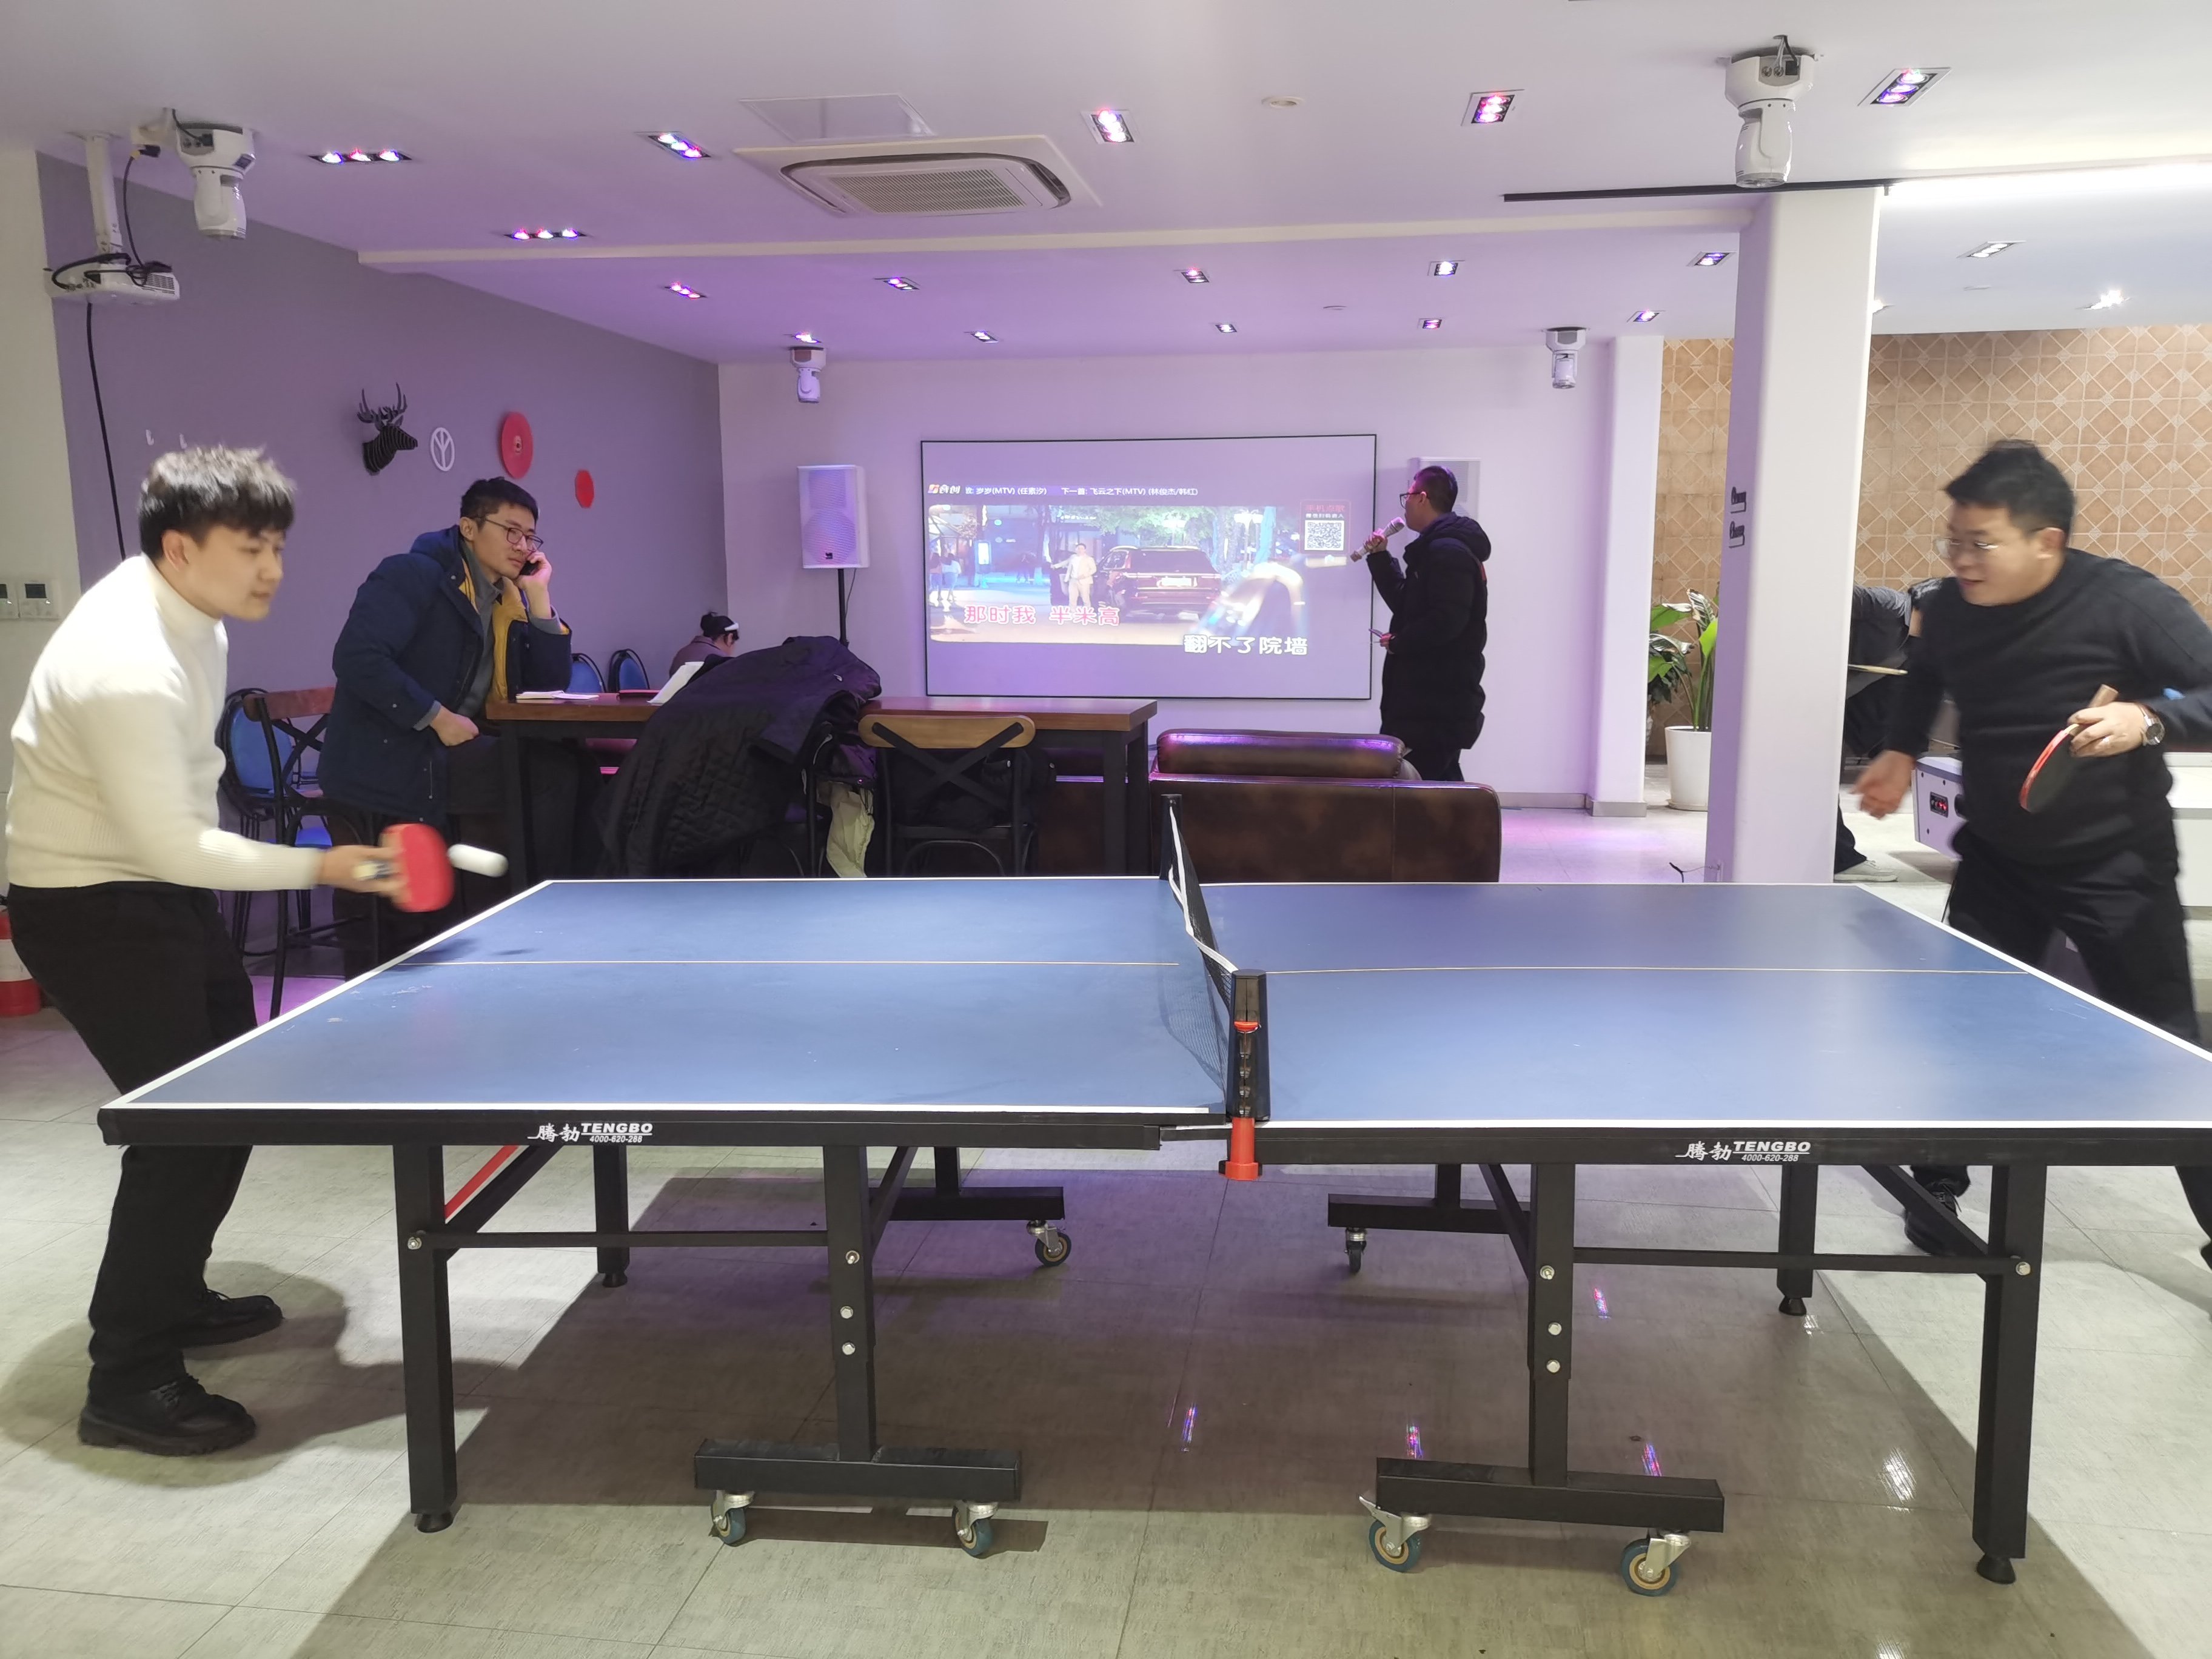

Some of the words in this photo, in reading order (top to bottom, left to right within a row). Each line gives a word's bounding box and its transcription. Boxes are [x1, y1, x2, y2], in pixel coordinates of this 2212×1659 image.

[964, 605, 1036, 625] 那时我
[1049, 606, 1121, 626] 半米高
[1184, 635, 1308, 655] 翻不了院墙
[581, 1123, 653, 1133] TENGBO
[1733, 1141, 1811, 1152] TENGBO
